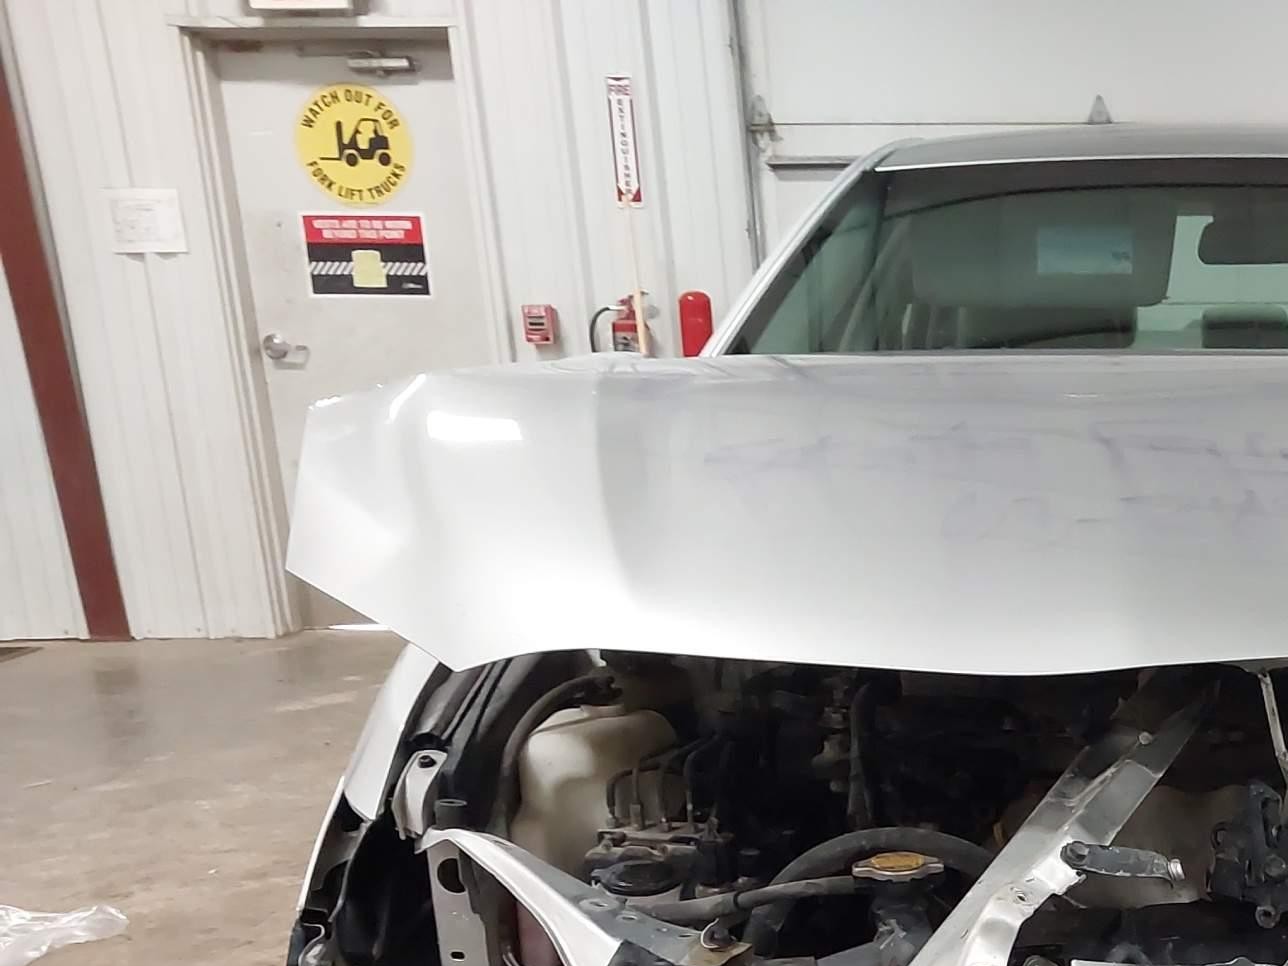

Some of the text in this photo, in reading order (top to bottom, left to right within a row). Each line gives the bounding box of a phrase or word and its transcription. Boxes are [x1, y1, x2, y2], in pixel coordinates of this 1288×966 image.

[301, 88, 400, 129] WATCH OUT FOR
[306, 160, 406, 201] FORK LIFT TRUCKS
